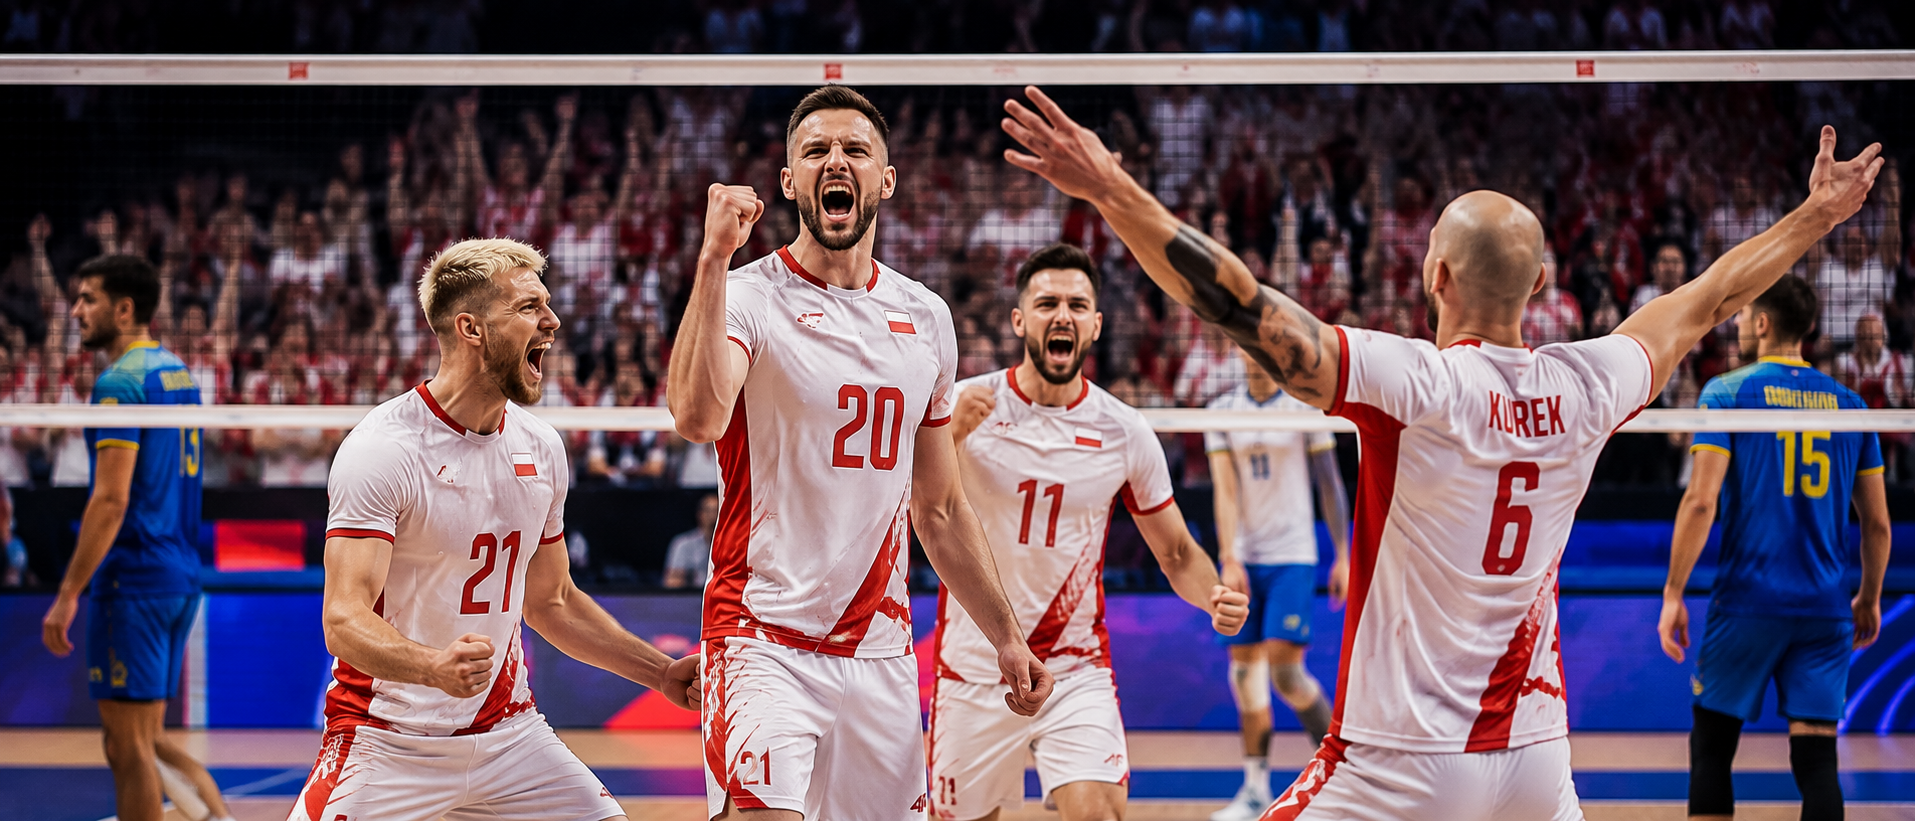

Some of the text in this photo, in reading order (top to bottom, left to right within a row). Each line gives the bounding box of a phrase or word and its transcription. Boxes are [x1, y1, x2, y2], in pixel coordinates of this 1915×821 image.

[832, 384, 904, 471] 20
[1489, 390, 1566, 438] KUREK
[1776, 430, 1831, 498] 15
[1017, 479, 1064, 548] 11
[1482, 461, 1540, 576] 6
[460, 530, 521, 614] 21
[740, 746, 771, 786] 21
